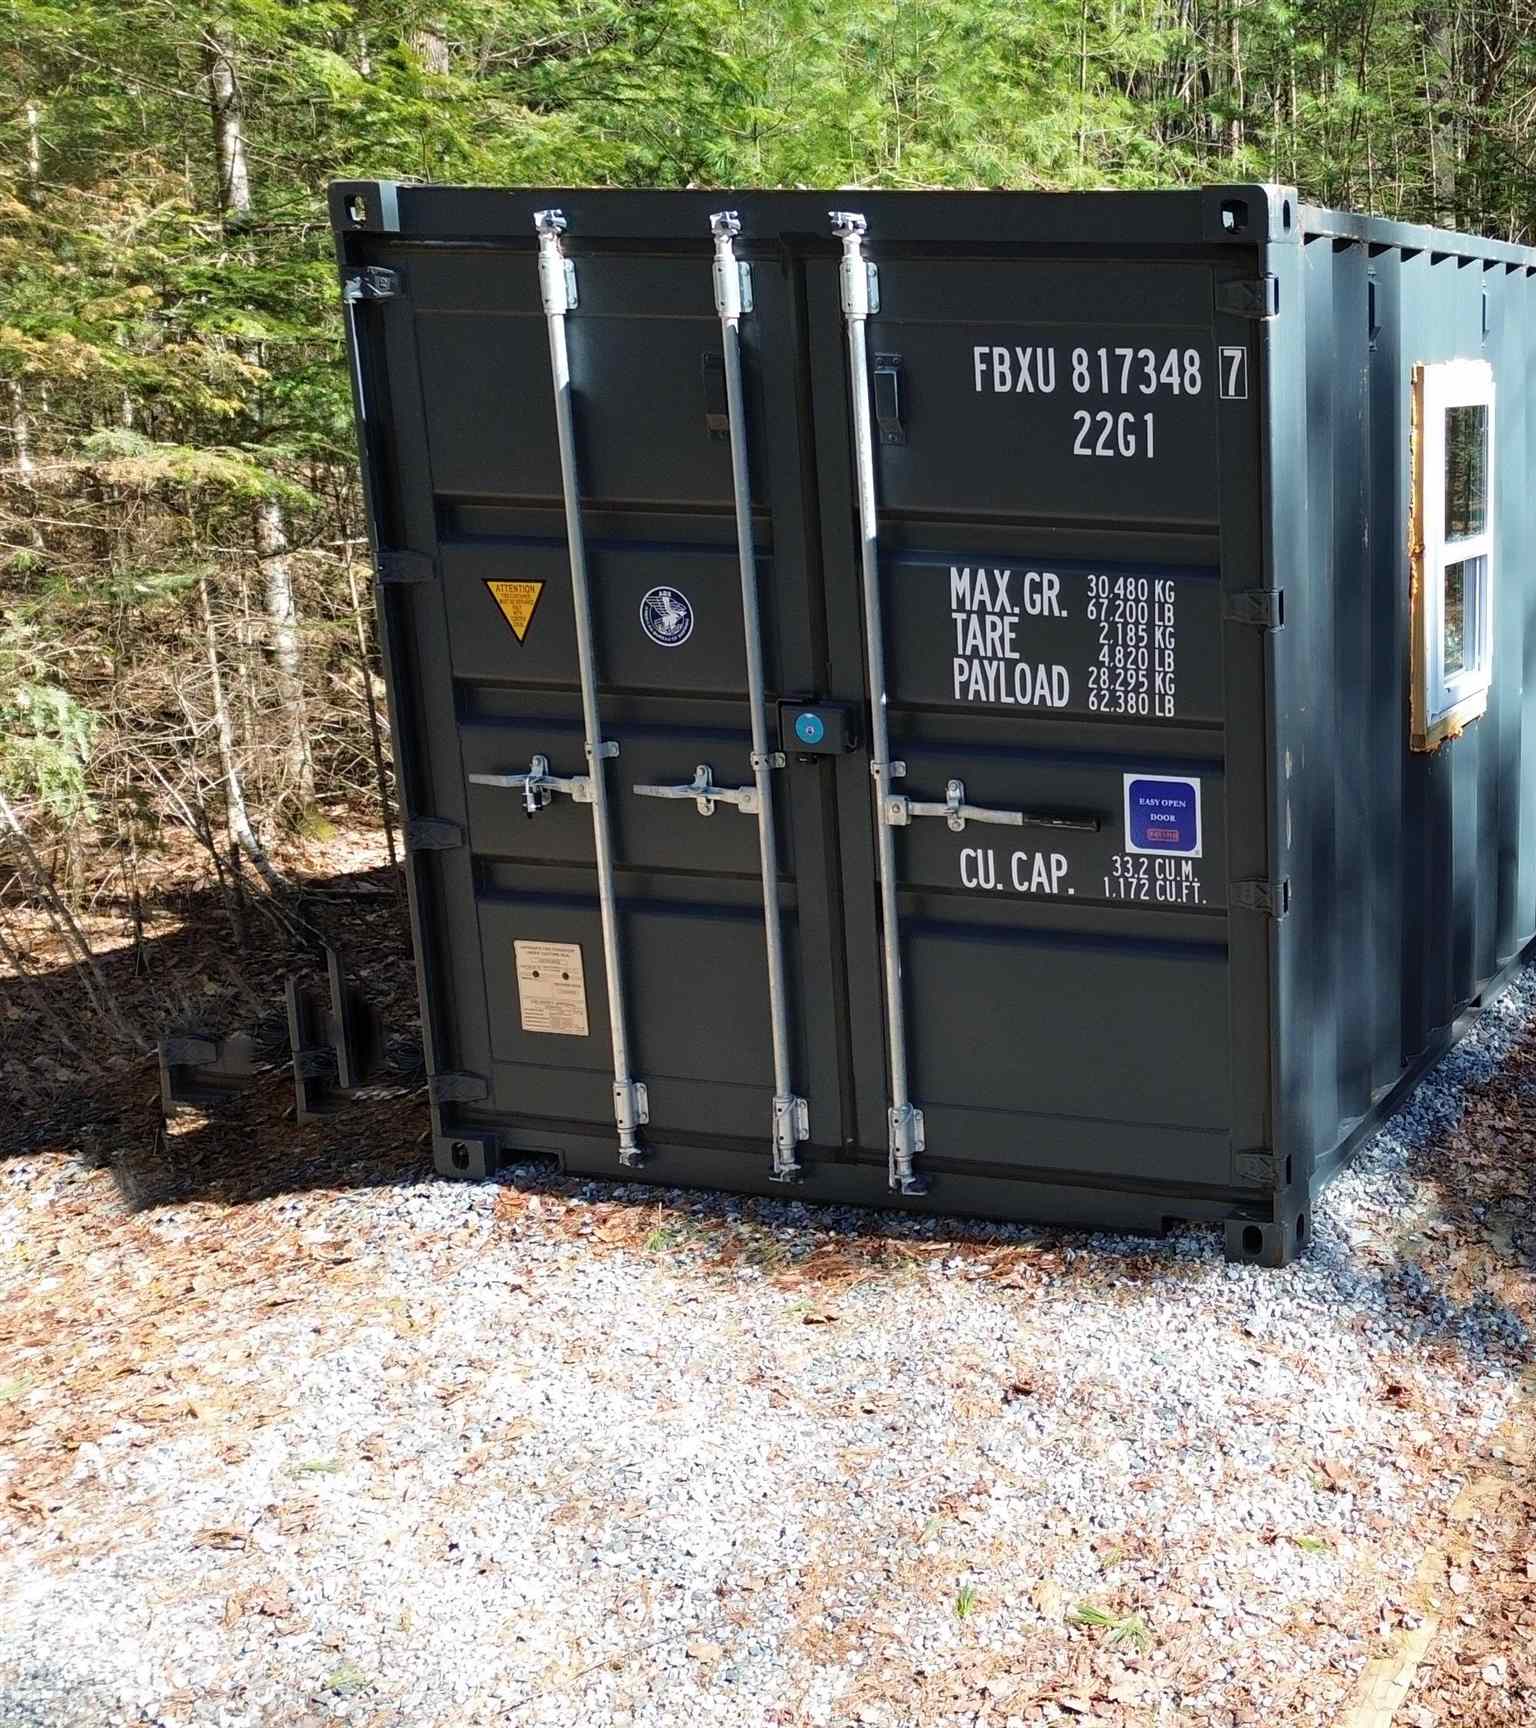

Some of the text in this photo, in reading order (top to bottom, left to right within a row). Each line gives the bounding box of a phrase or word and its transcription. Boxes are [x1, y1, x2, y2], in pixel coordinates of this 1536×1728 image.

[974, 346, 1242, 396] FBXU 817348 7
[1074, 410, 1153, 458] 22G1
[496, 584, 535, 593] ATTENTION
[1087, 575, 1175, 602] 30,480 KG
[1087, 600, 1174, 626] 67,200 LB
[952, 613, 1020, 659] TARE
[1099, 622, 1175, 649] 2,185 KG
[1099, 648, 1174, 672] 4,820 LB
[954, 658, 1070, 707] PAYLOAD
[1088, 667, 1175, 695] 28,295 KG
[1089, 690, 1175, 717] 62,380 LB
[1139, 798, 1160, 806] EASY
[1150, 814, 1177, 822] DOOR
[960, 848, 1074, 894] CU. CAP.
[1112, 856, 1149, 878] 33.2
